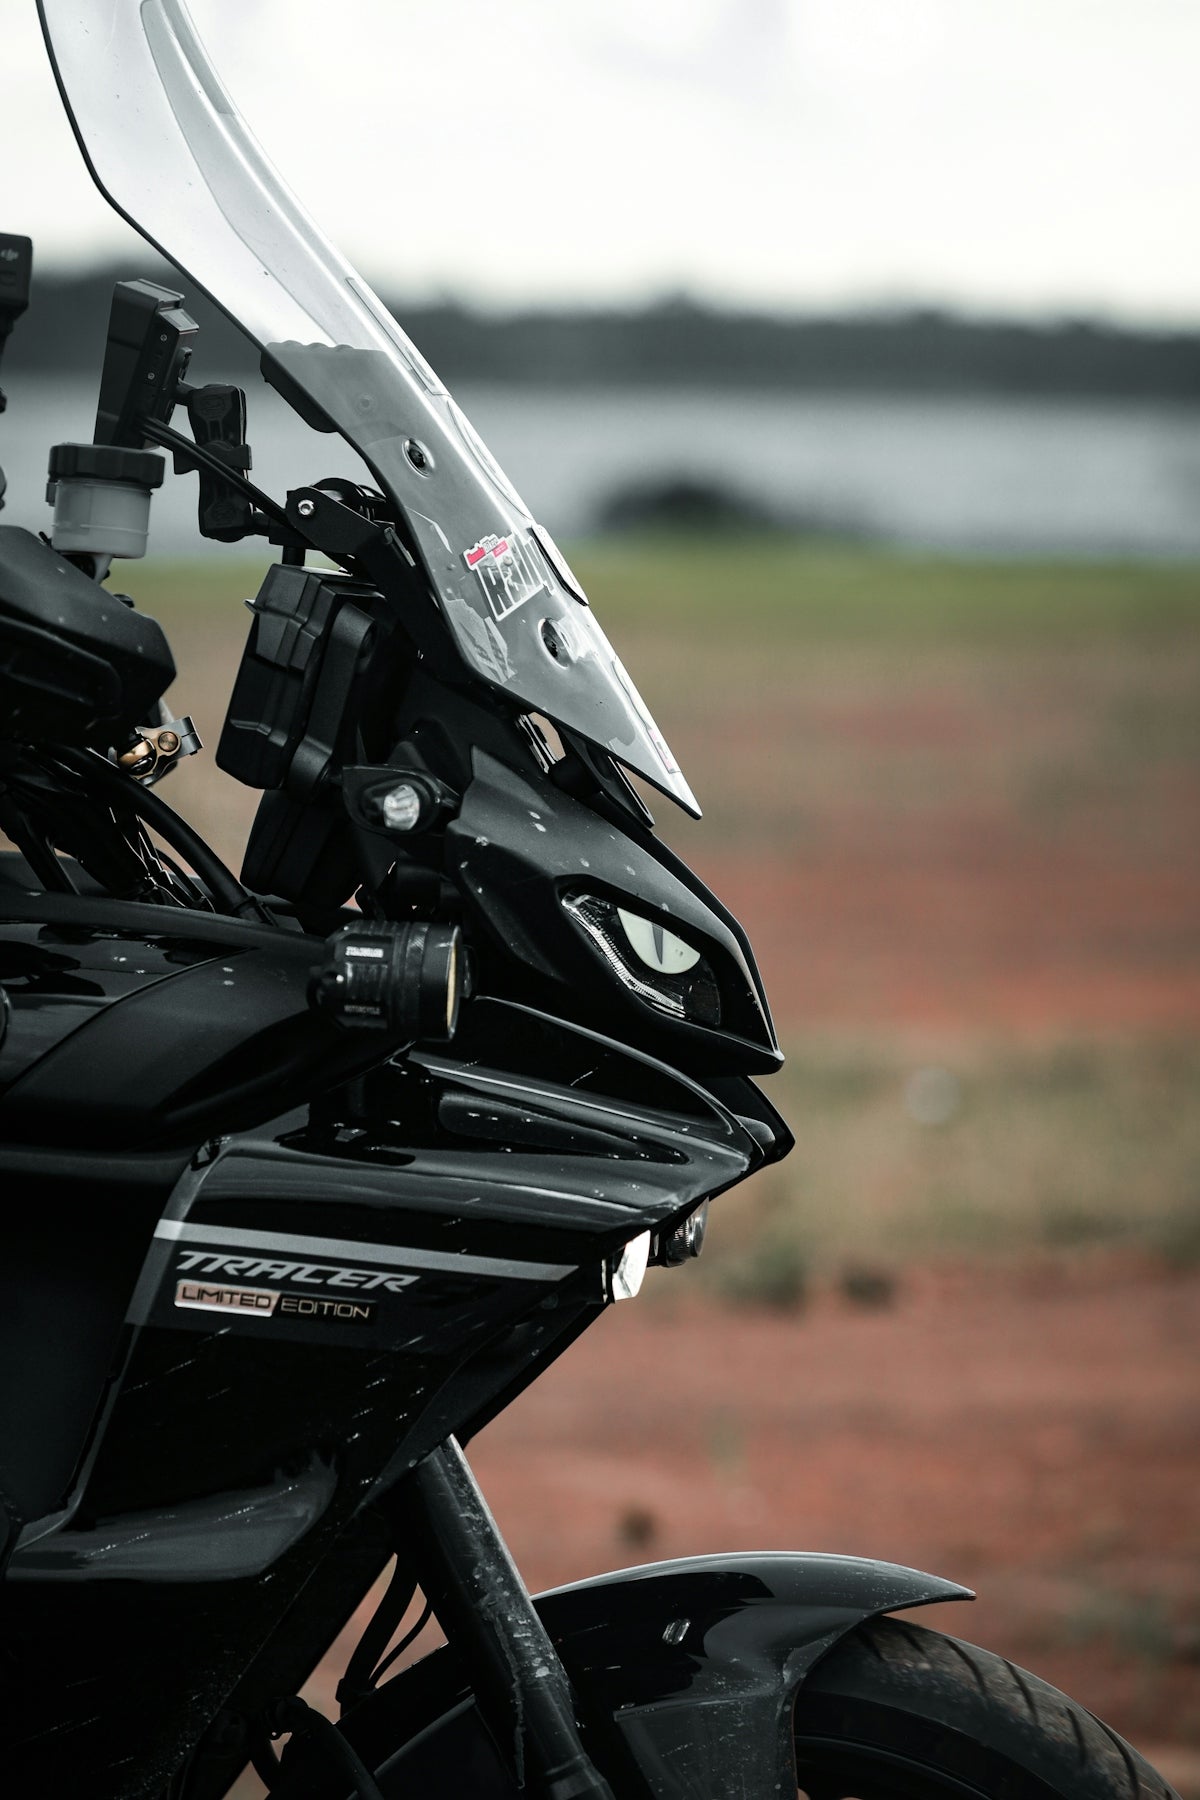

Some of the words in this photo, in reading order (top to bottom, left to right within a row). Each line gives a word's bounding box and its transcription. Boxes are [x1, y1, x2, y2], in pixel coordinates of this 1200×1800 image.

[176, 1250, 421, 1293] TRACER
[181, 1285, 272, 1309] LIMITED
[281, 1298, 371, 1319] EDITION
